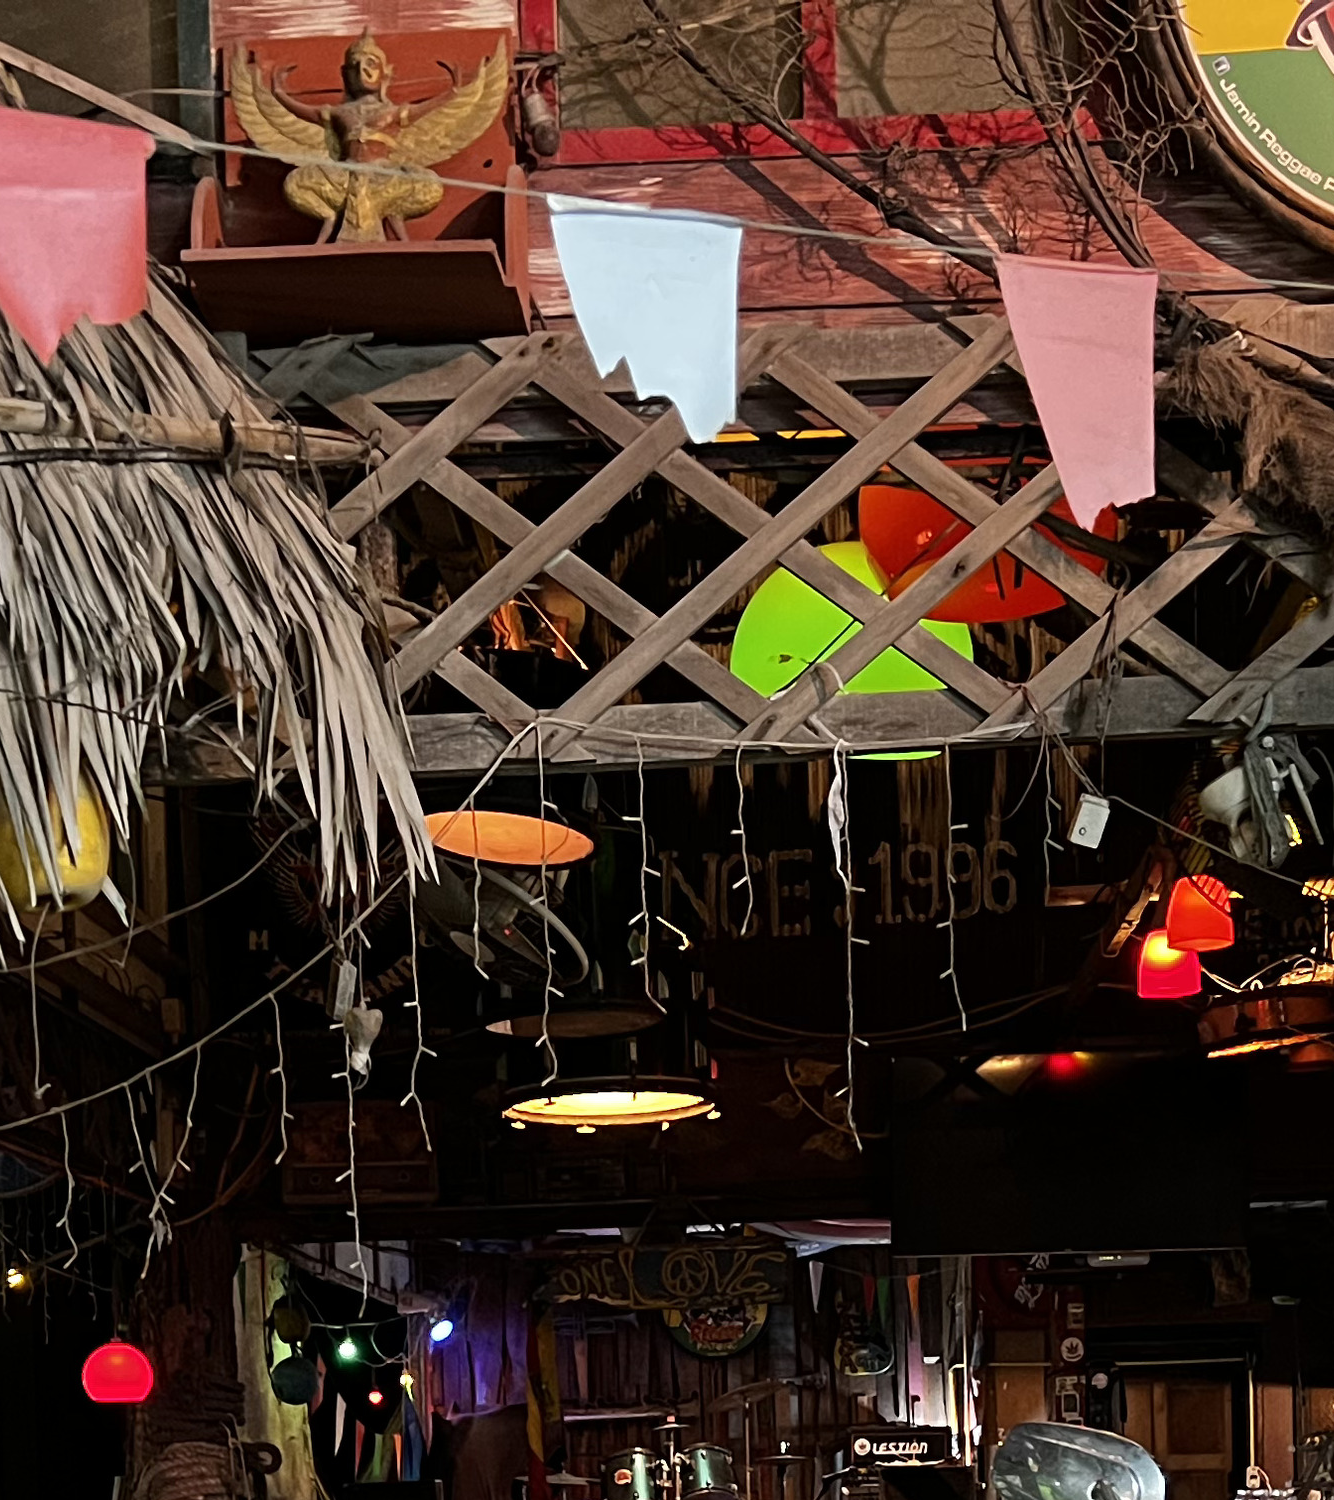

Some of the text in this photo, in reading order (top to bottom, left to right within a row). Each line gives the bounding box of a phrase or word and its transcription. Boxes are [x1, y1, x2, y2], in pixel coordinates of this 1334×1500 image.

[1219, 78, 1262, 133] Jamin
[1259, 128, 1323, 185] Reggae
[868, 840, 1018, 925] 1996
